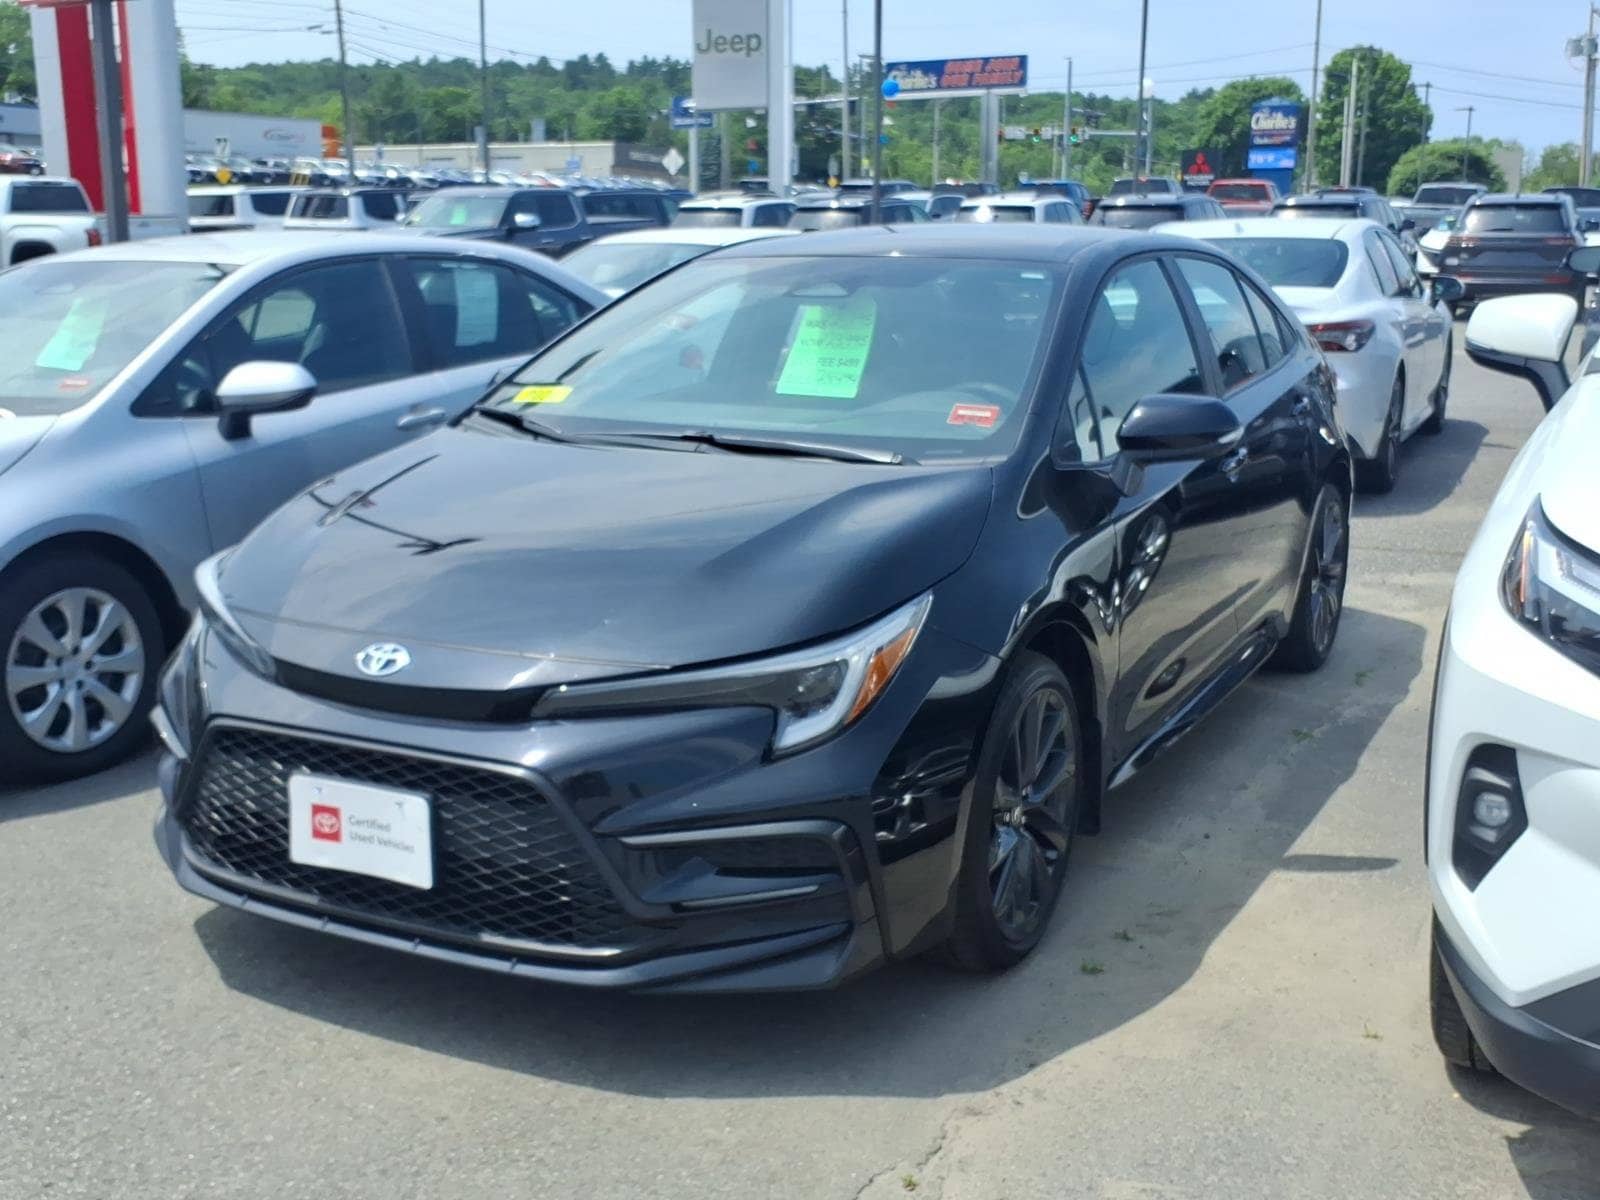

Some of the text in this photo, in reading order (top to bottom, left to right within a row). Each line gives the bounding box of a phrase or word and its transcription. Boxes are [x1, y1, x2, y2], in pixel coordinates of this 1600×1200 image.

[696, 29, 762, 57] Jeep
[348, 814, 391, 832] Certified
[349, 833, 415, 854] Used Vehicles
